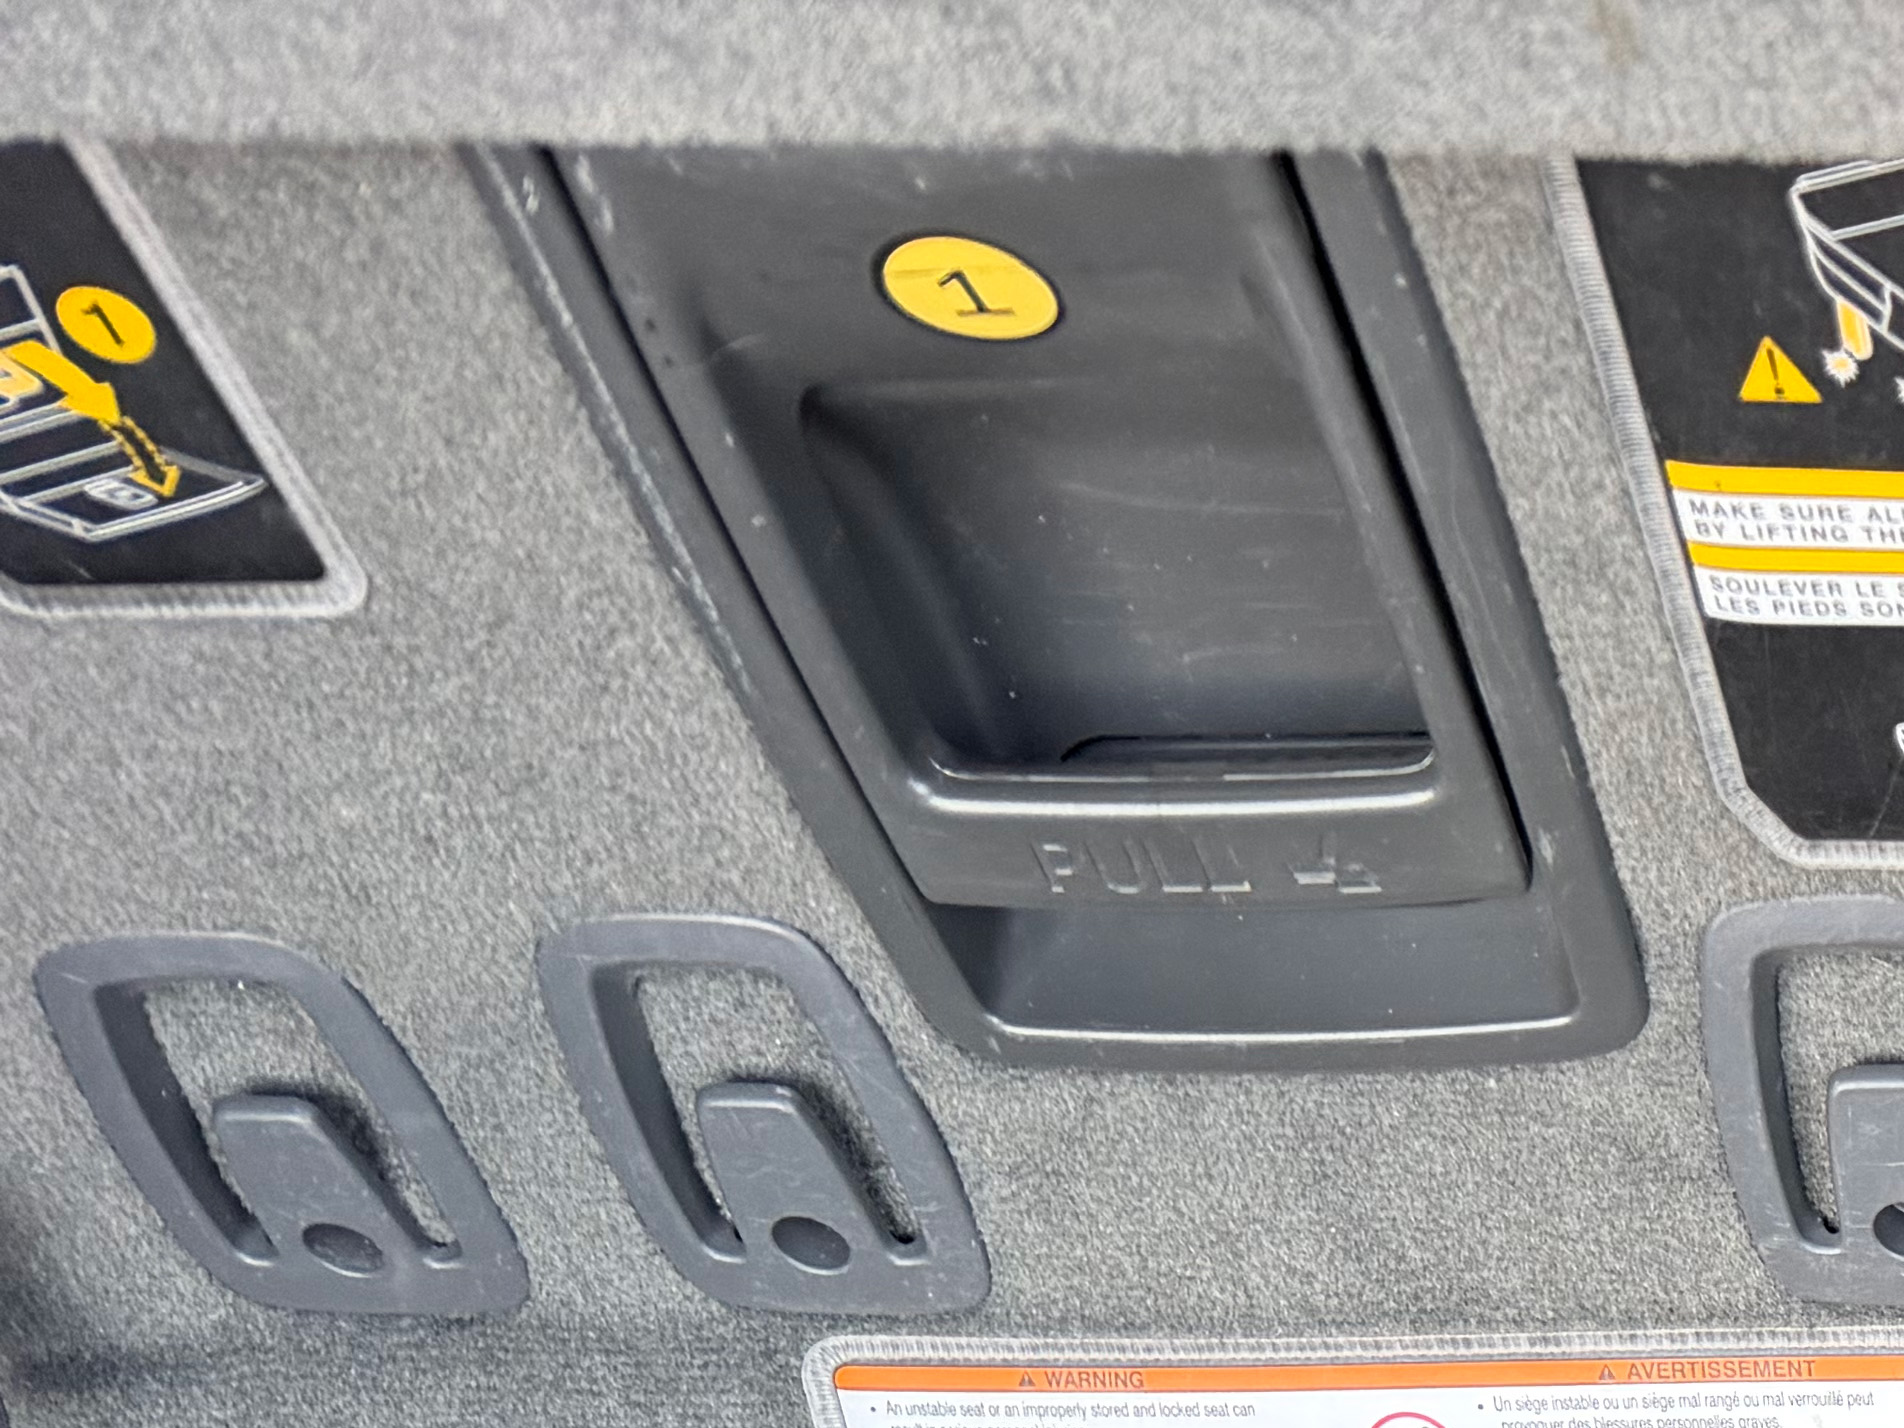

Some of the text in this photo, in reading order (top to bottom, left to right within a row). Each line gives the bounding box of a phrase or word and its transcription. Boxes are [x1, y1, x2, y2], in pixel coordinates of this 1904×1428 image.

[937, 268, 1016, 318] 1
[80, 302, 125, 347] 1
[1689, 499, 1767, 521] MAKE
[1780, 501, 1852, 523] SURE
[1694, 520, 1726, 541] BY
[1741, 522, 1849, 543] LIFTING
[1709, 574, 1843, 598] SOULEVER
[1855, 580, 1885, 599] LE
[1714, 594, 1760, 616] LES
[1773, 598, 1848, 618] PIEDS
[1030, 838, 1252, 893] PULL
[1044, 1371, 1145, 1389] WARNING
[1627, 1359, 1816, 1380] AVERTISSEMENT
[886, 1400, 1256, 1421] An unstable seat or an improperly stored and locked seat can
[1493, 1395, 1512, 1412] Un
[1515, 1394, 1549, 1415] siège
[1551, 1394, 1600, 1410] instable
[1603, 1397, 1620, 1410] ou
[1622, 1396, 1639, 1410] un
[1642, 1392, 1675, 1412] siège
[1679, 1392, 1701, 1408] mal
[1704, 1391, 1740, 1411] rangé
[1743, 1395, 1760, 1408] ou
[1762, 1391, 1785, 1407] mal
[1847, 1392, 1875, 1411] peut
